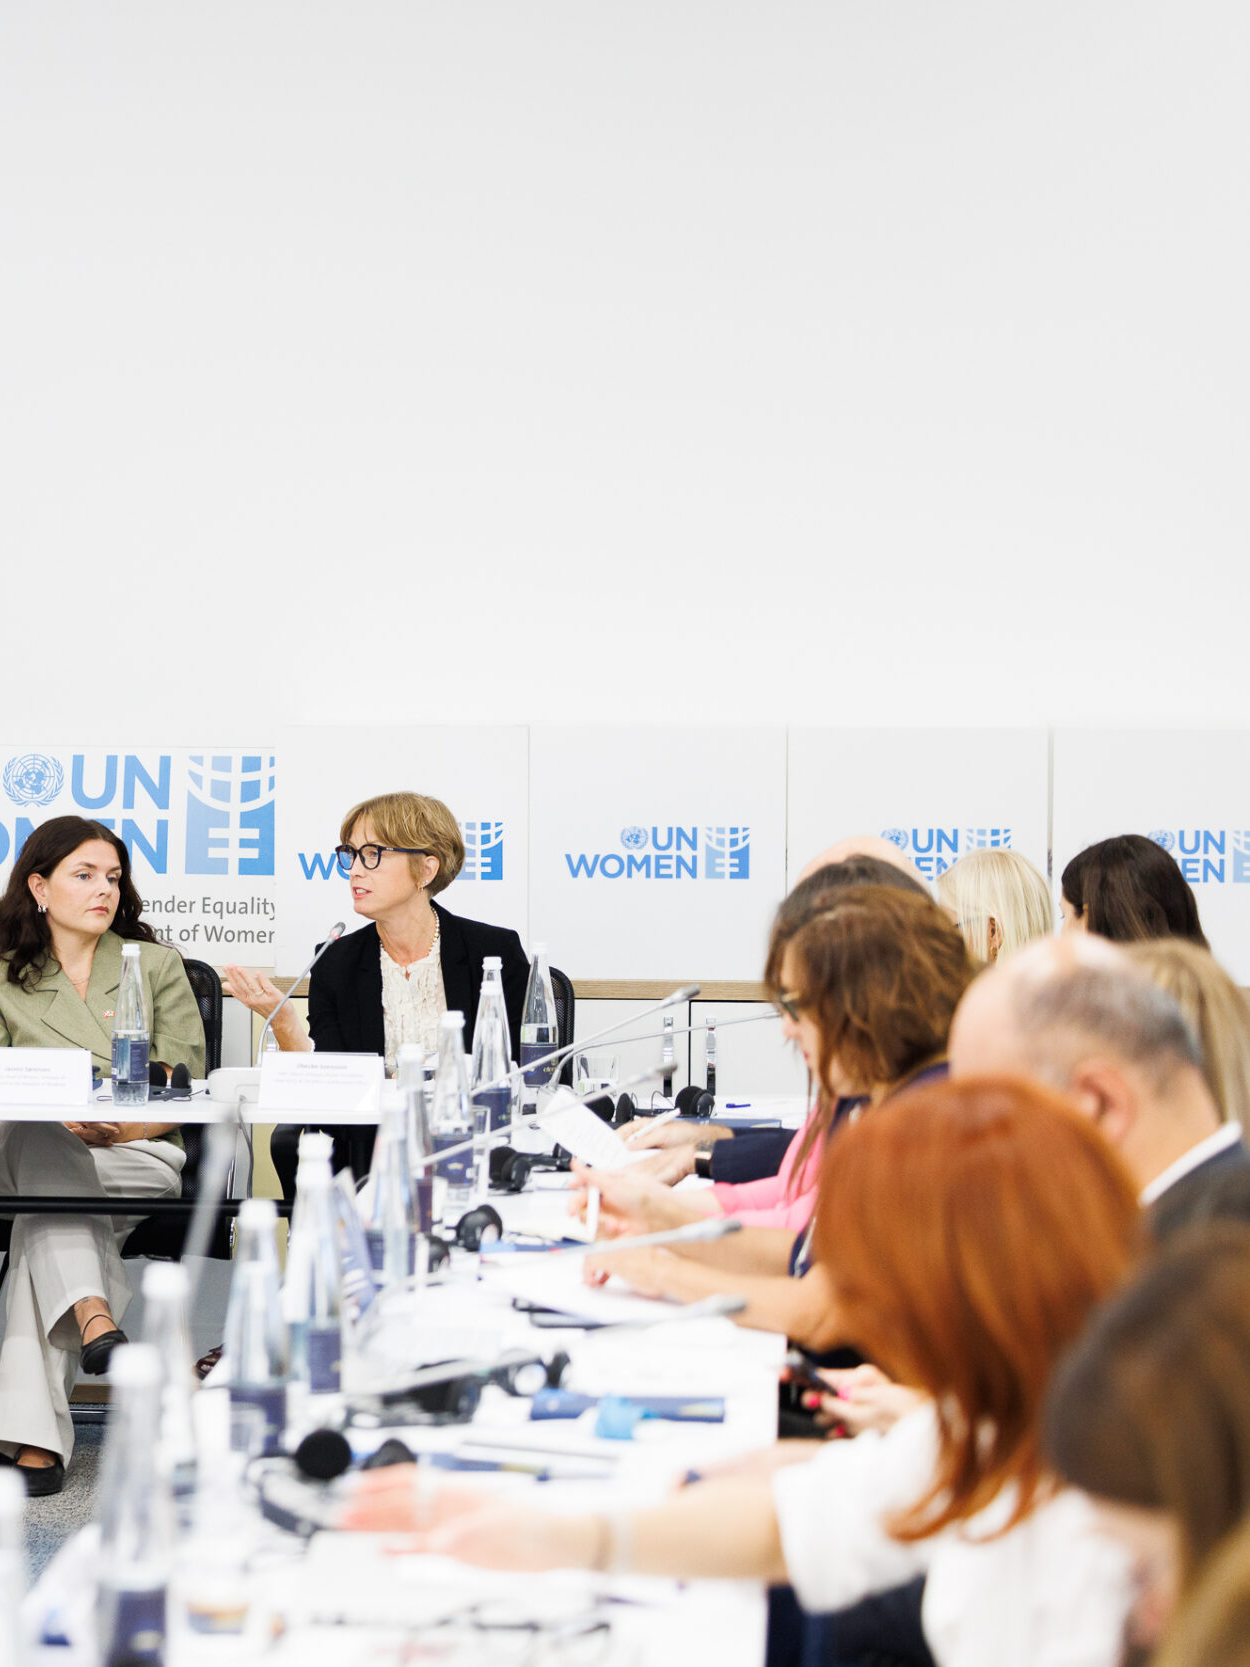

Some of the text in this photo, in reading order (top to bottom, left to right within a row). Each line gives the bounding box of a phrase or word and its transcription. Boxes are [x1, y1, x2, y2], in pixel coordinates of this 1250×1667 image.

[71, 754, 171, 810] UN
[652, 826, 698, 851] UN
[912, 828, 959, 853] UN
[1178, 830, 1226, 855] UN
[565, 854, 698, 879] WOMEN
[141, 895, 196, 914] ender
[179, 923, 200, 942] of
